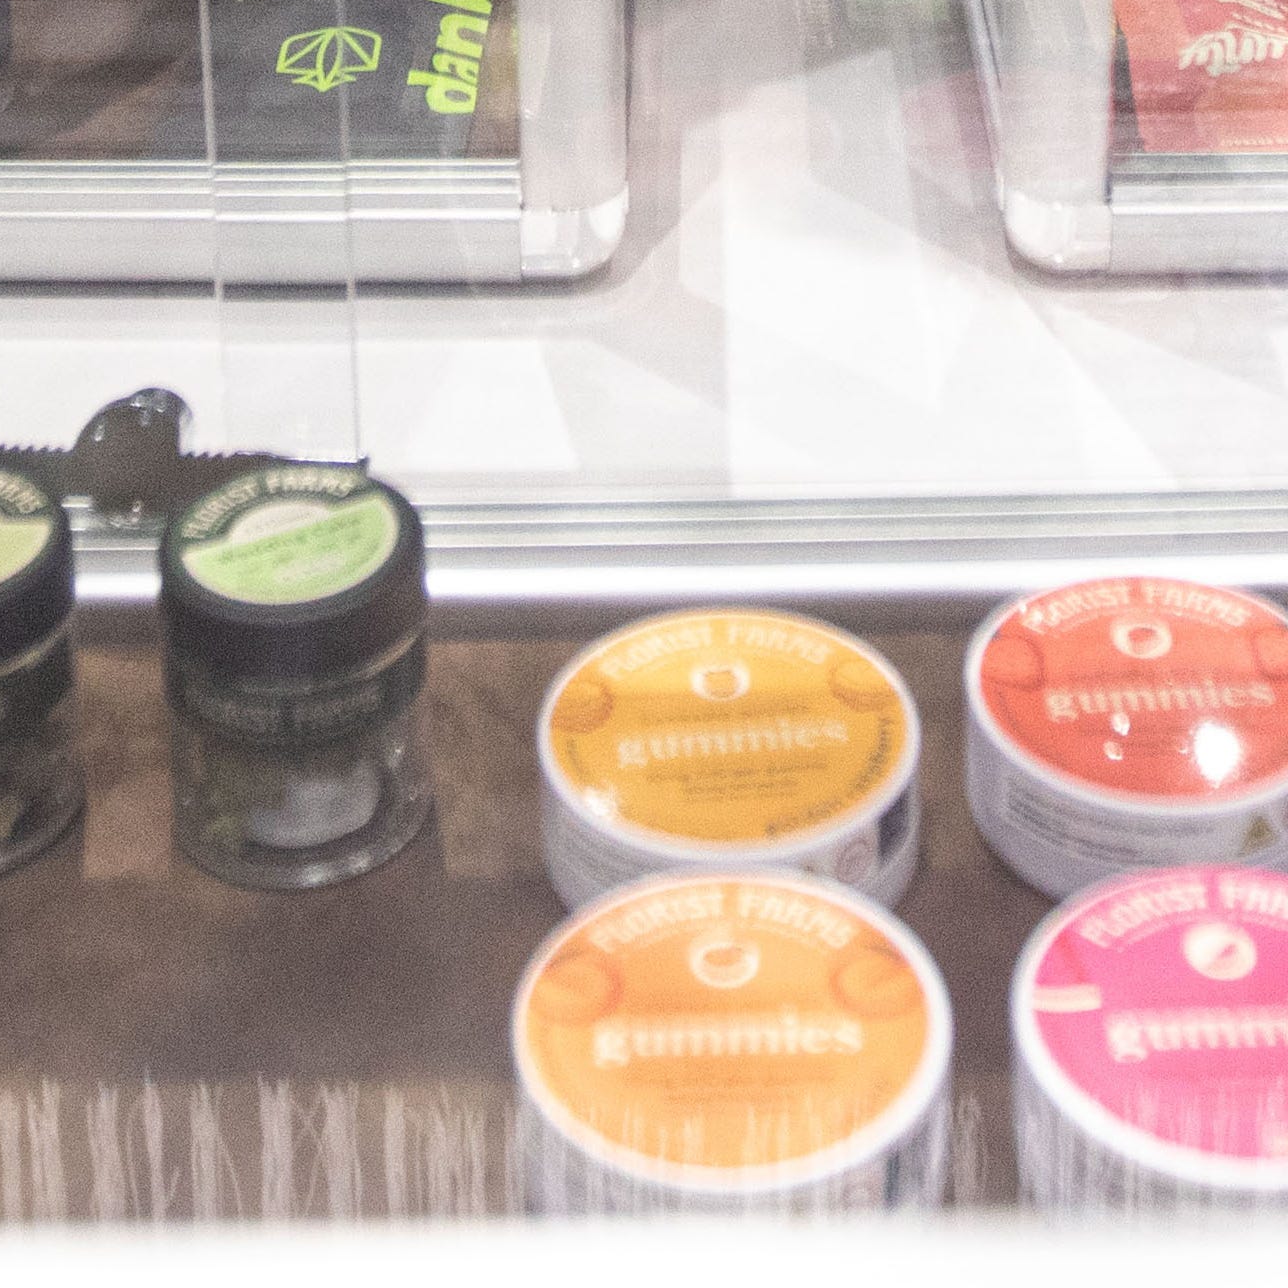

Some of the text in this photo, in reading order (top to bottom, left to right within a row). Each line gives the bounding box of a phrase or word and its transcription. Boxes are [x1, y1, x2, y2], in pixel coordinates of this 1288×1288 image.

[1141, 582, 1252, 628] FARMS
[1043, 676, 1275, 724] gummies
[615, 716, 850, 770] gummies
[591, 1006, 864, 1068] gummies
